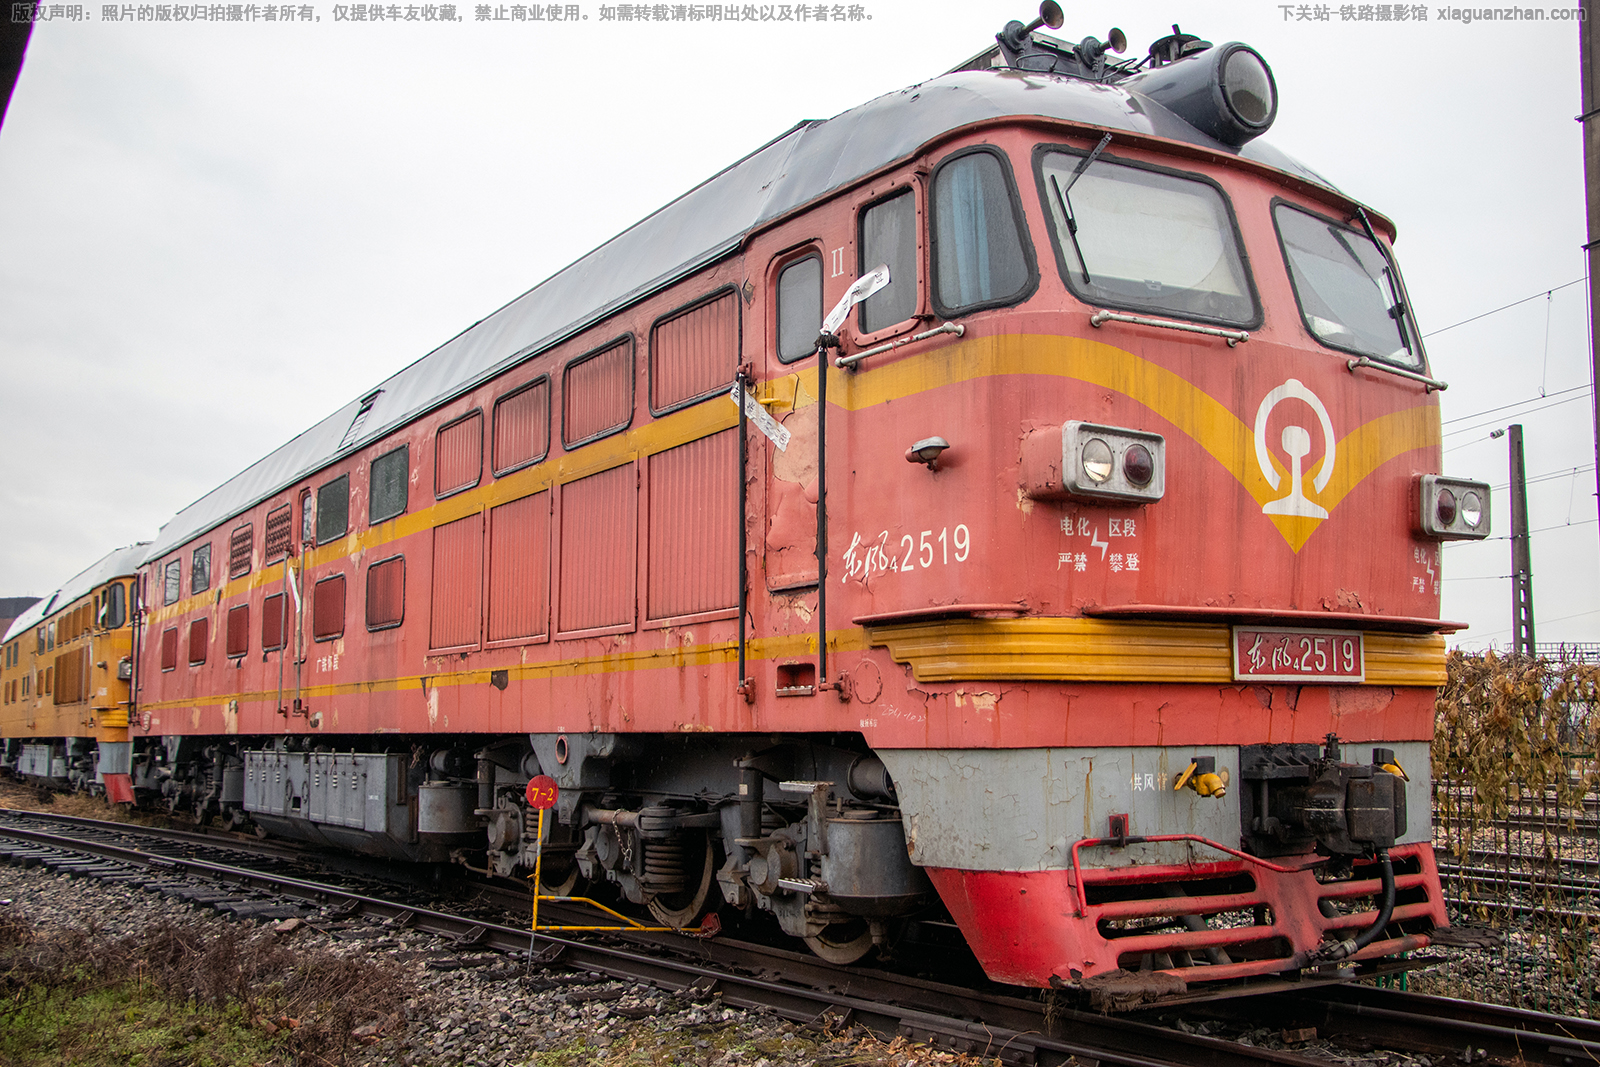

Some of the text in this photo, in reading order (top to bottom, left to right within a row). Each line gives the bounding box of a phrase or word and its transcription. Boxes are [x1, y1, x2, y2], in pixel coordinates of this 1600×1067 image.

[1060, 516, 1137, 538] 电化 区段
[1057, 552, 1140, 573] 严禁 攀登
[1129, 772, 1168, 792] 供风管
[531, 787, 555, 802] 7-2
